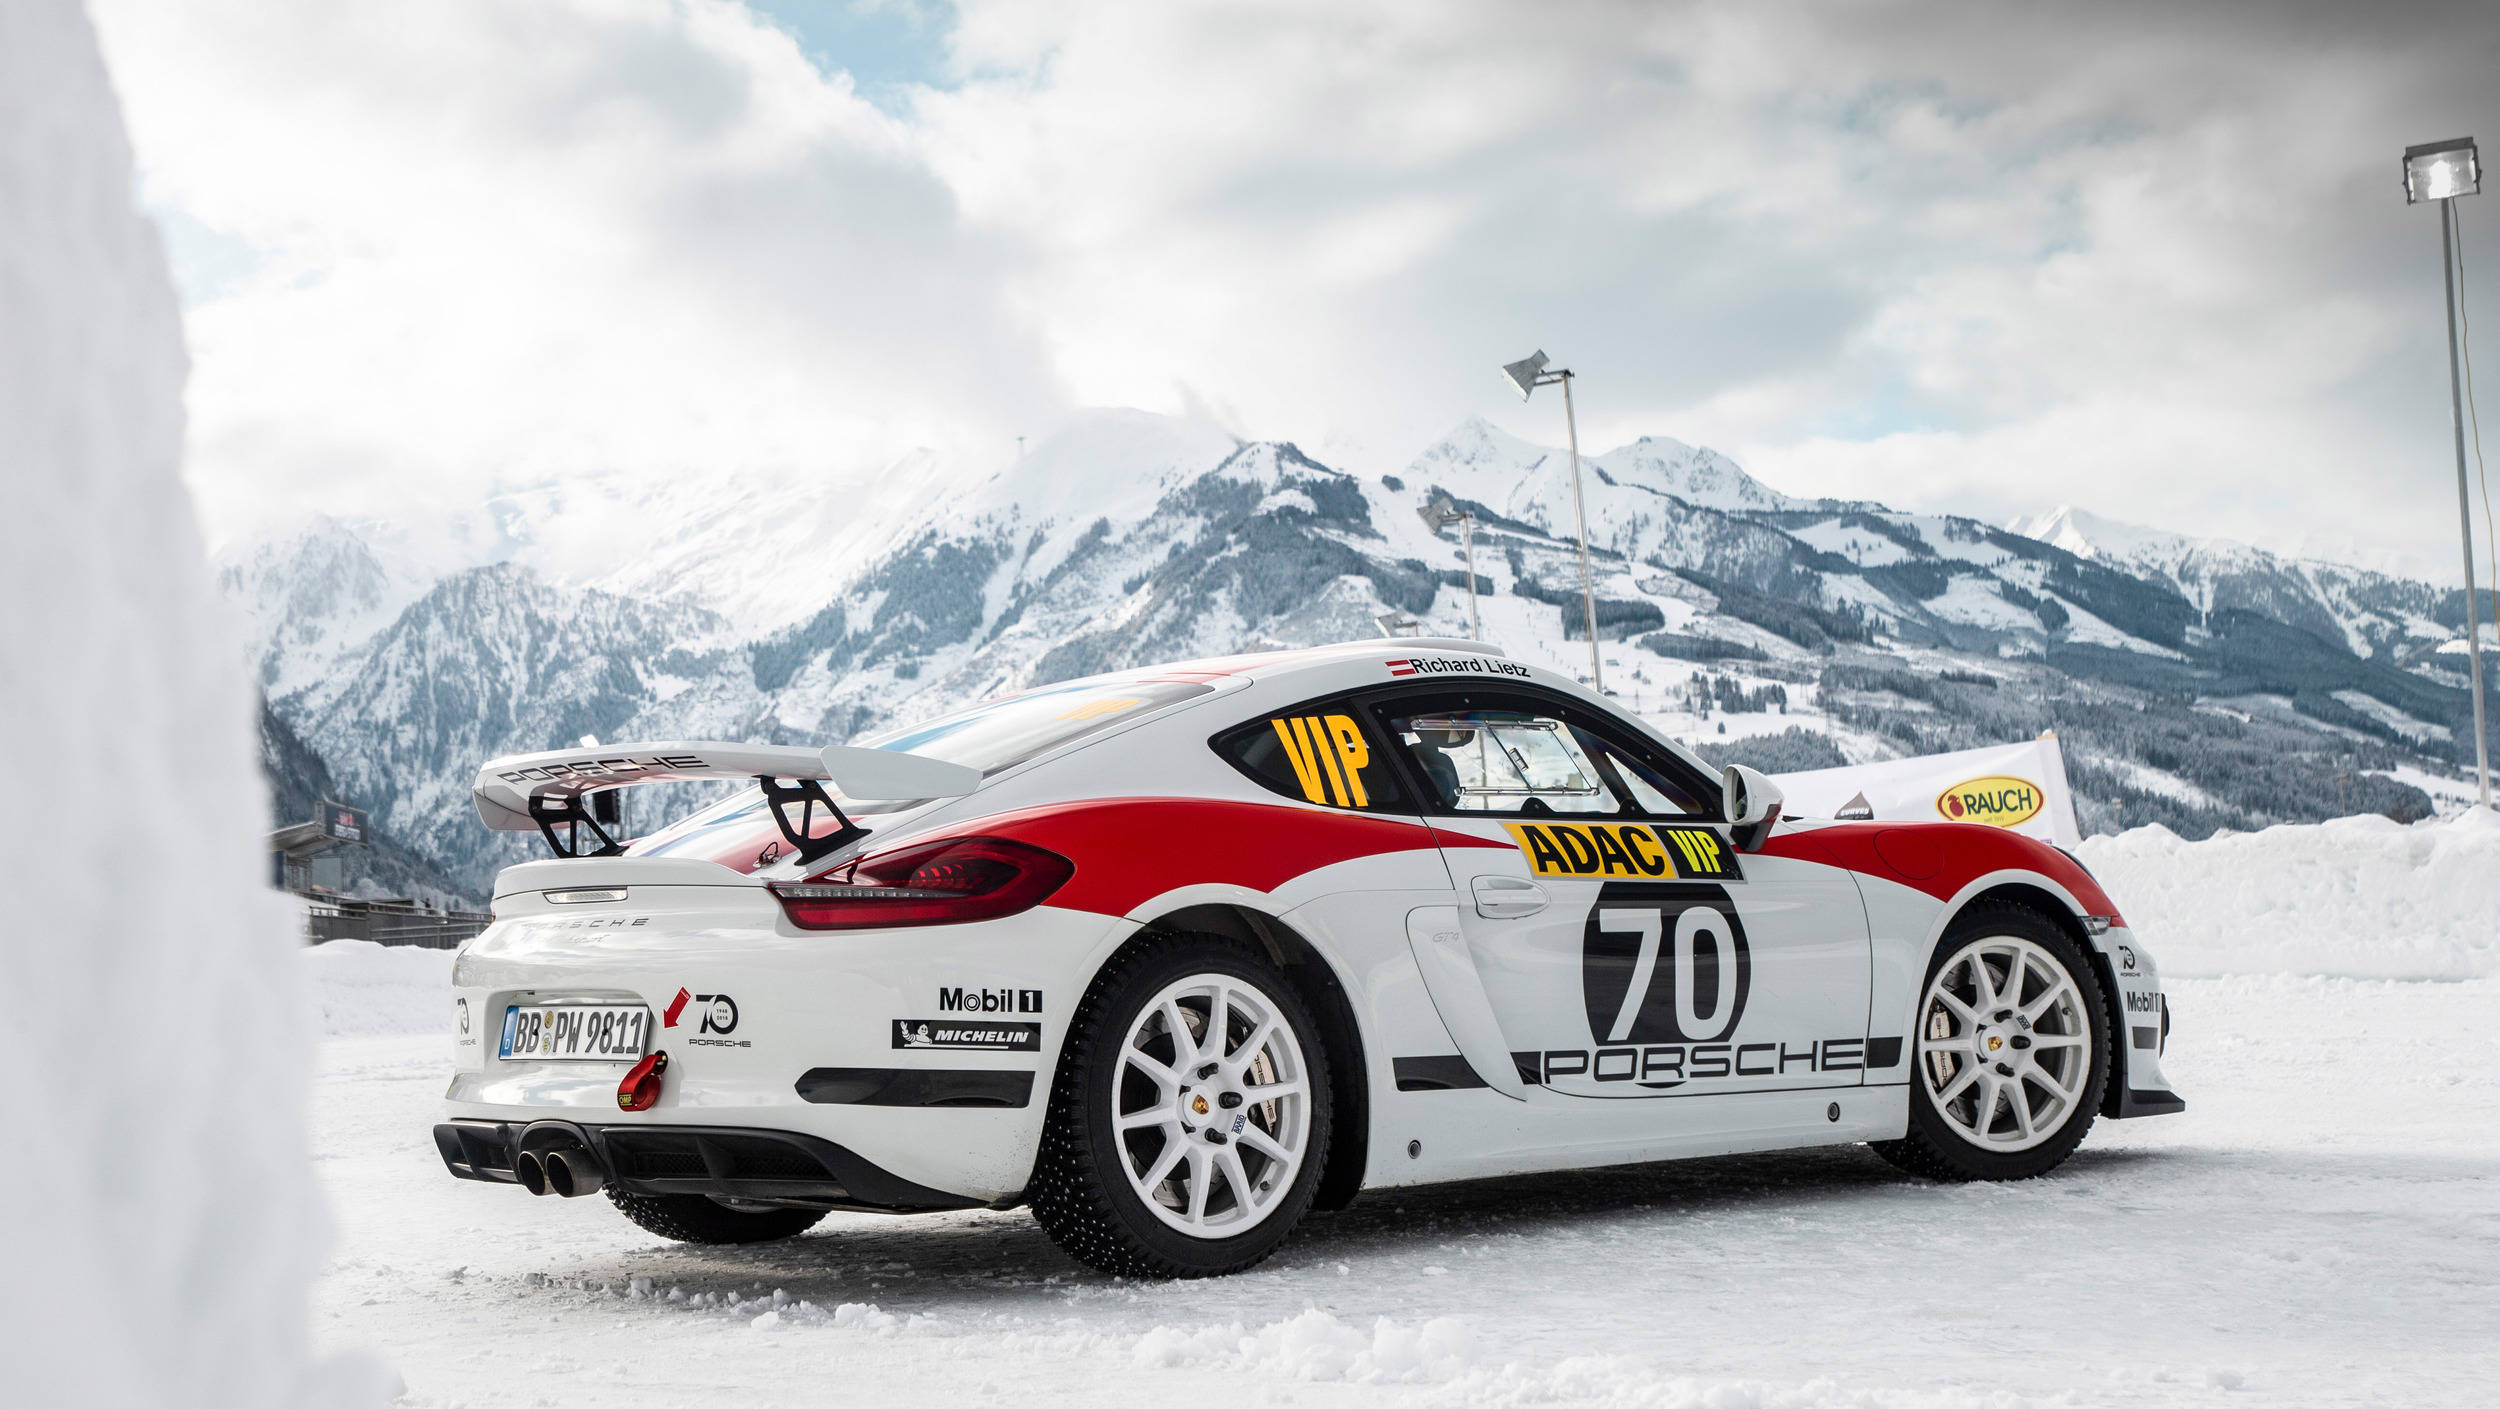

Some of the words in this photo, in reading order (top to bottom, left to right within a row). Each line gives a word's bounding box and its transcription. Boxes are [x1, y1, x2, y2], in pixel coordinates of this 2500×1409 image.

[1409, 657, 1483, 674] Richard
[1484, 659, 1531, 678] Lietz
[496, 755, 711, 786] PORSCHE
[1271, 714, 1369, 807] VIP
[1963, 787, 2033, 815] RAUCH
[1520, 825, 1665, 876] ADAC
[1666, 829, 1722, 873] VIP
[2118, 945, 2136, 970] 70
[1599, 906, 1738, 1042] 70
[696, 994, 739, 1035] 70
[940, 987, 1013, 1013] Mobil
[2126, 991, 2154, 1013] Mobil
[513, 1011, 542, 1053] BB
[552, 1011, 584, 1053] PW
[585, 1011, 643, 1054] 9811
[688, 1038, 752, 1048] PORSCHE
[934, 1029, 1029, 1043] MICHELIN
[1544, 1037, 1865, 1084] PORSCHE
